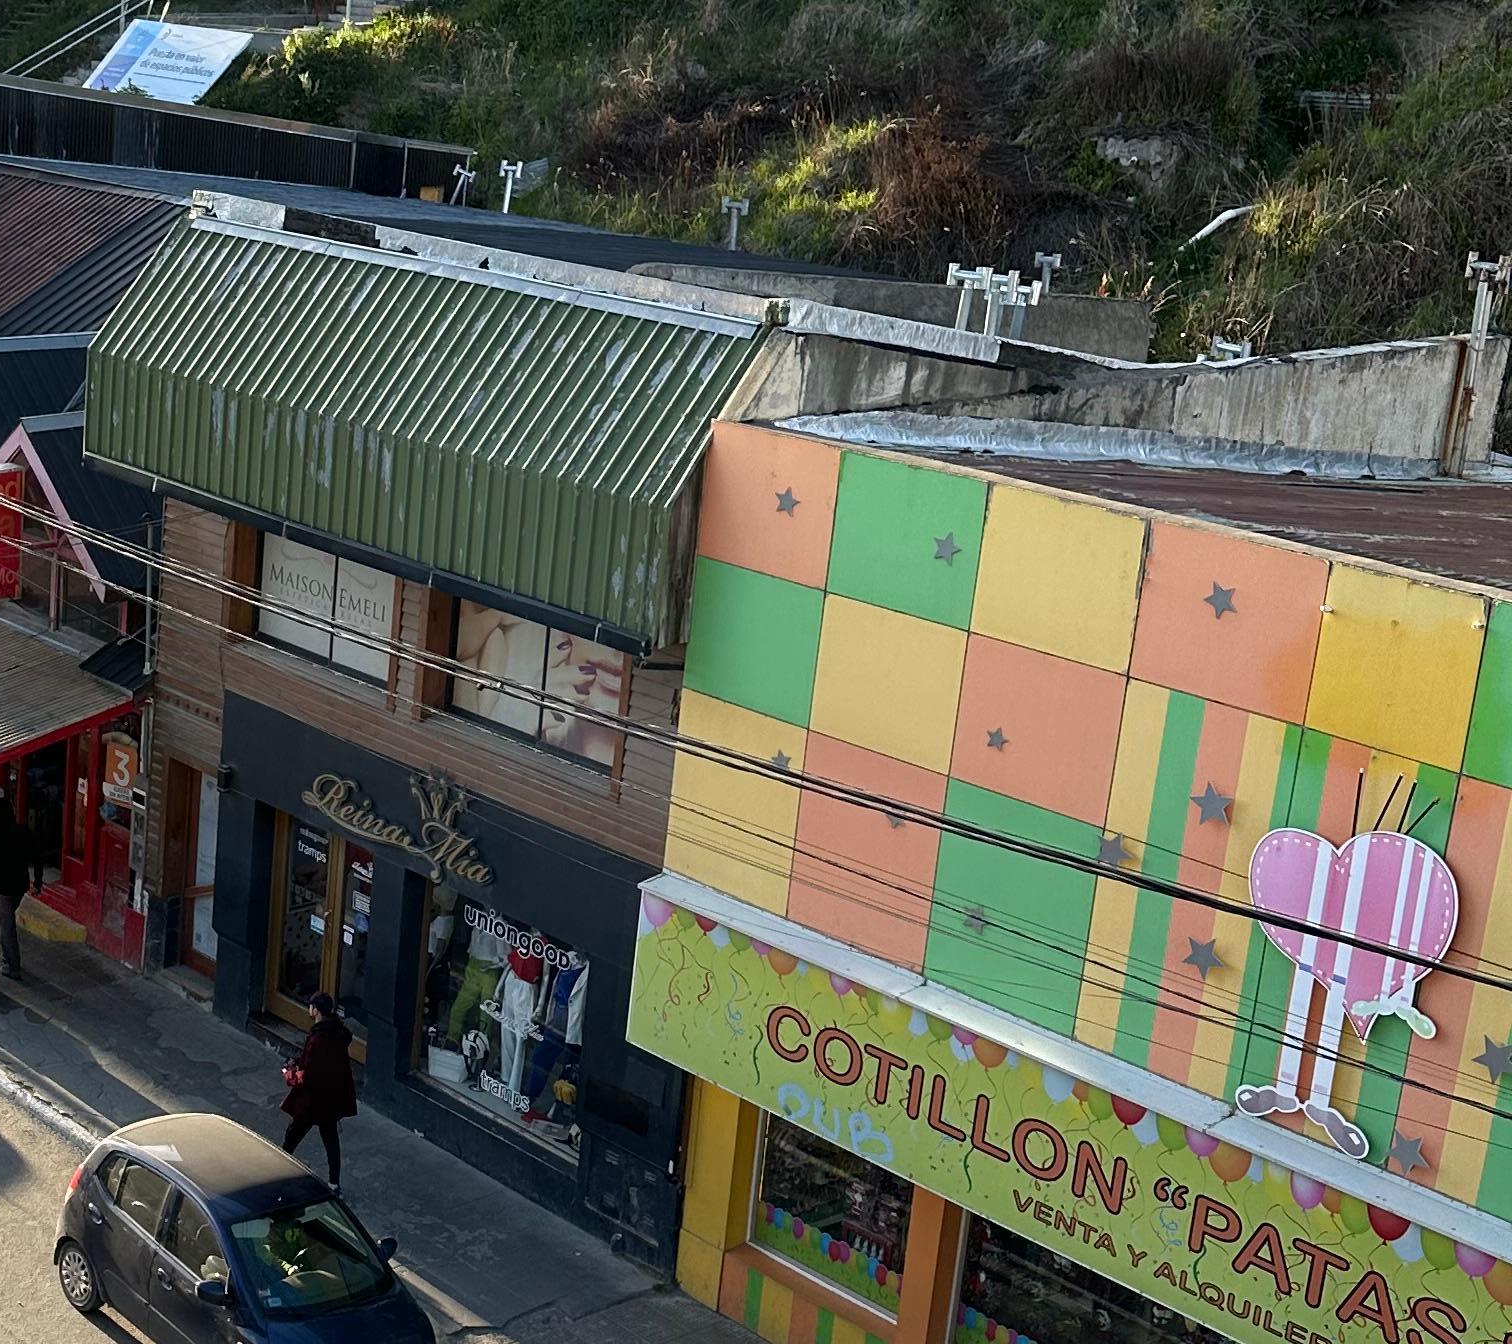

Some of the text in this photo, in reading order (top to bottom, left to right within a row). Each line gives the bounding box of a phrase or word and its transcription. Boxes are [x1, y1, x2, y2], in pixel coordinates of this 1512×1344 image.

[269, 563, 386, 623] MAISON EMELI
[112, 749, 130, 787] 3
[302, 774, 495, 885] Reina Mia
[480, 1070, 530, 1114] tramps
[767, 1005, 1128, 1215] COTILLON
[1013, 1189, 1117, 1258] VENTA
[1126, 1243, 1148, 1268] Y
